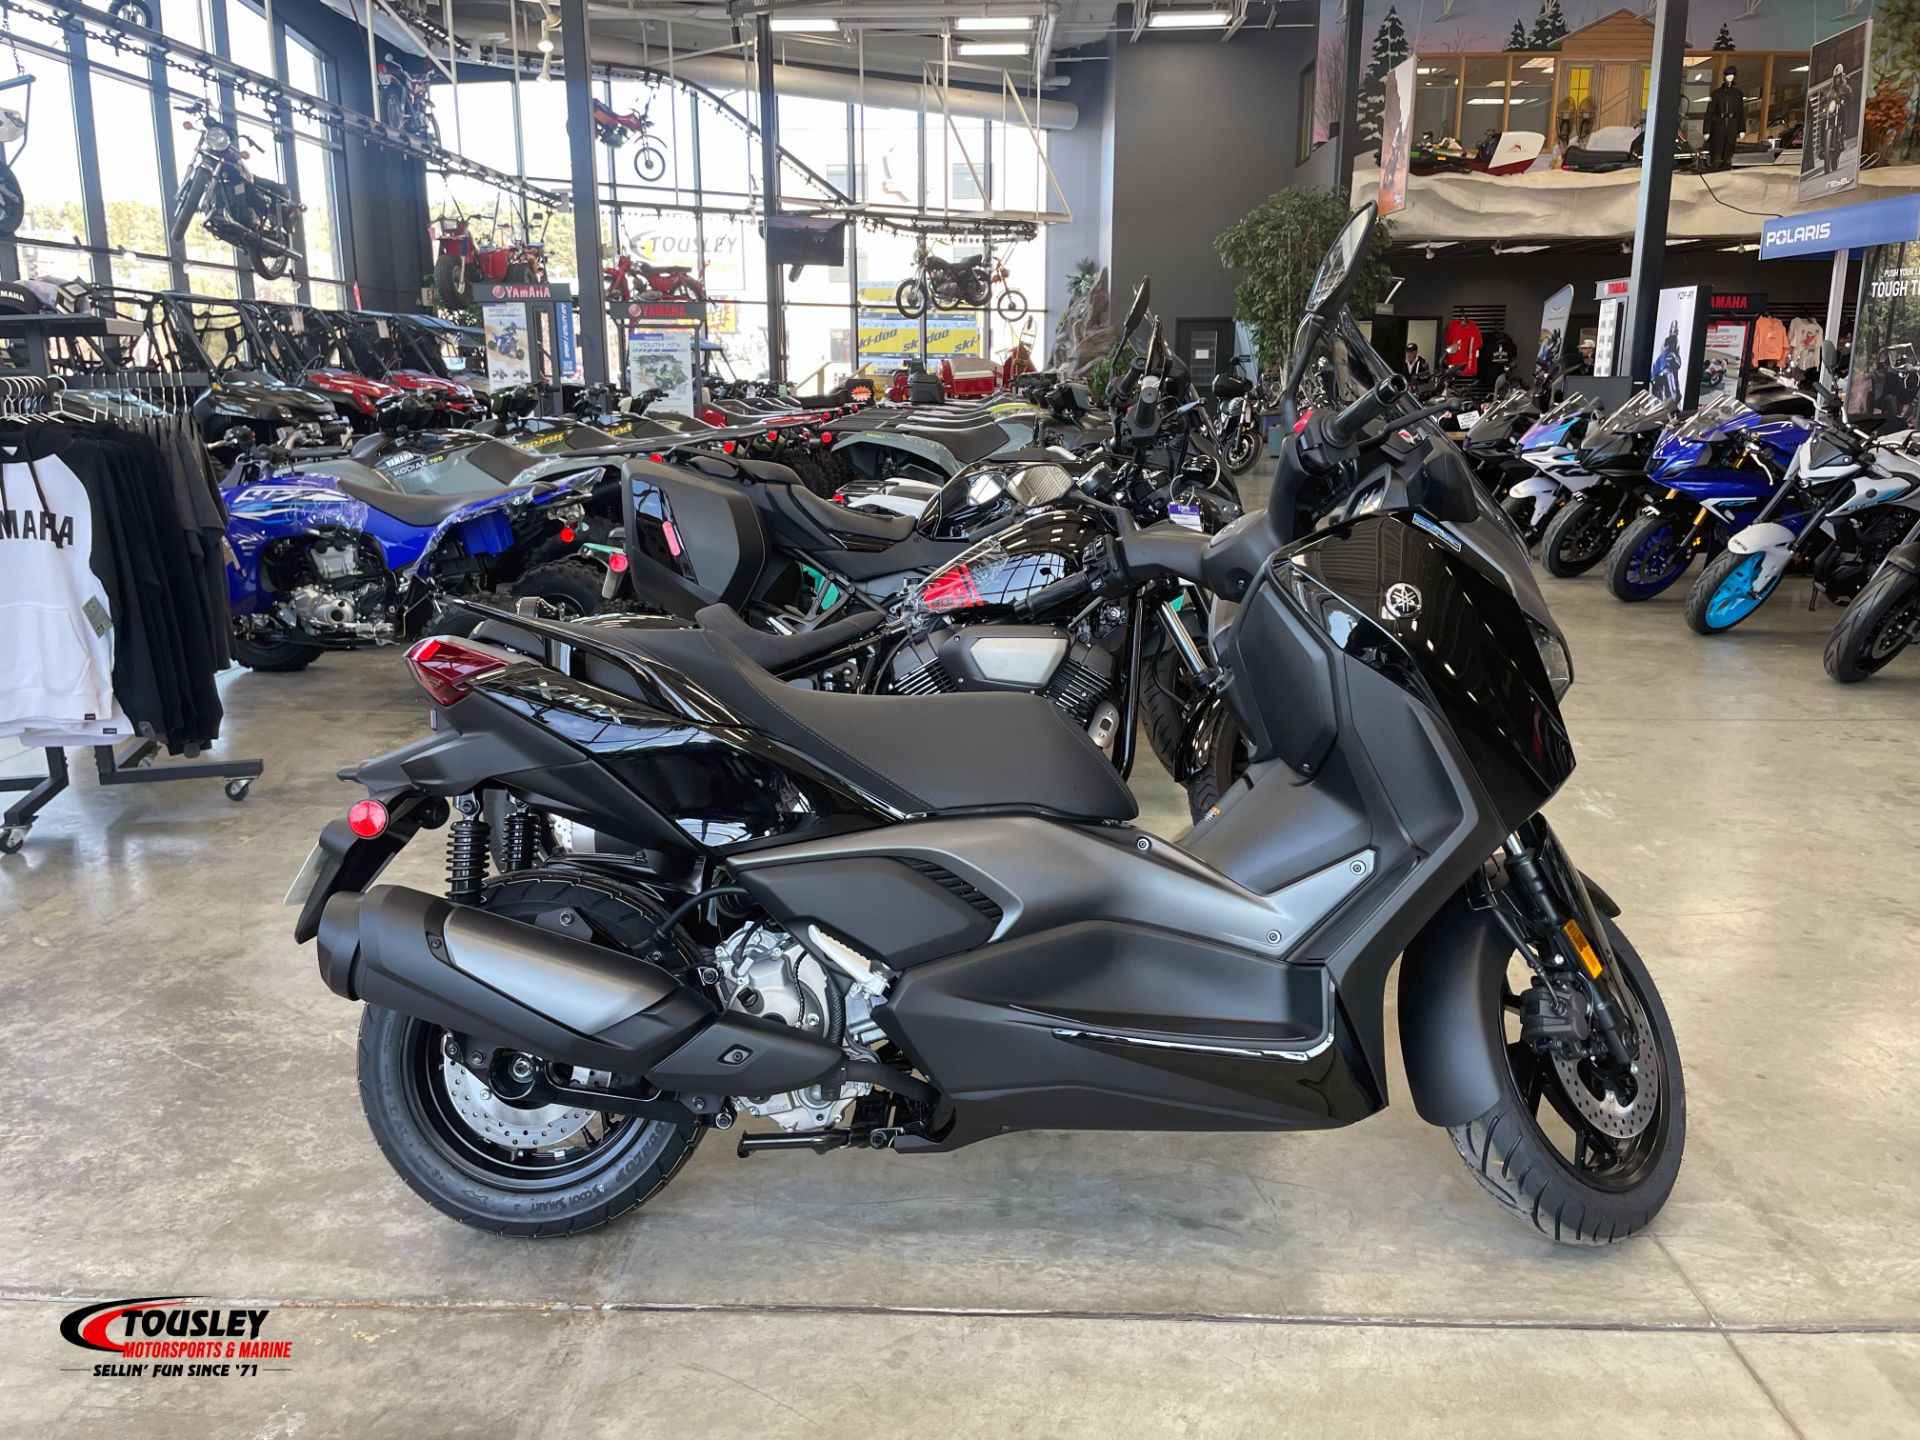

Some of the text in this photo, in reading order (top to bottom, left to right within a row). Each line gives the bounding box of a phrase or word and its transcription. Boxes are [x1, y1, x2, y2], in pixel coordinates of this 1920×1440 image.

[1766, 223, 1832, 247] POLARIS
[505, 286, 551, 298] YAMAHA
[1871, 280, 1920, 298] TOUGH T
[641, 304, 685, 316] YAMAHA
[385, 451, 413, 467] YAMAHA
[394, 456, 444, 476] KODIAK 700
